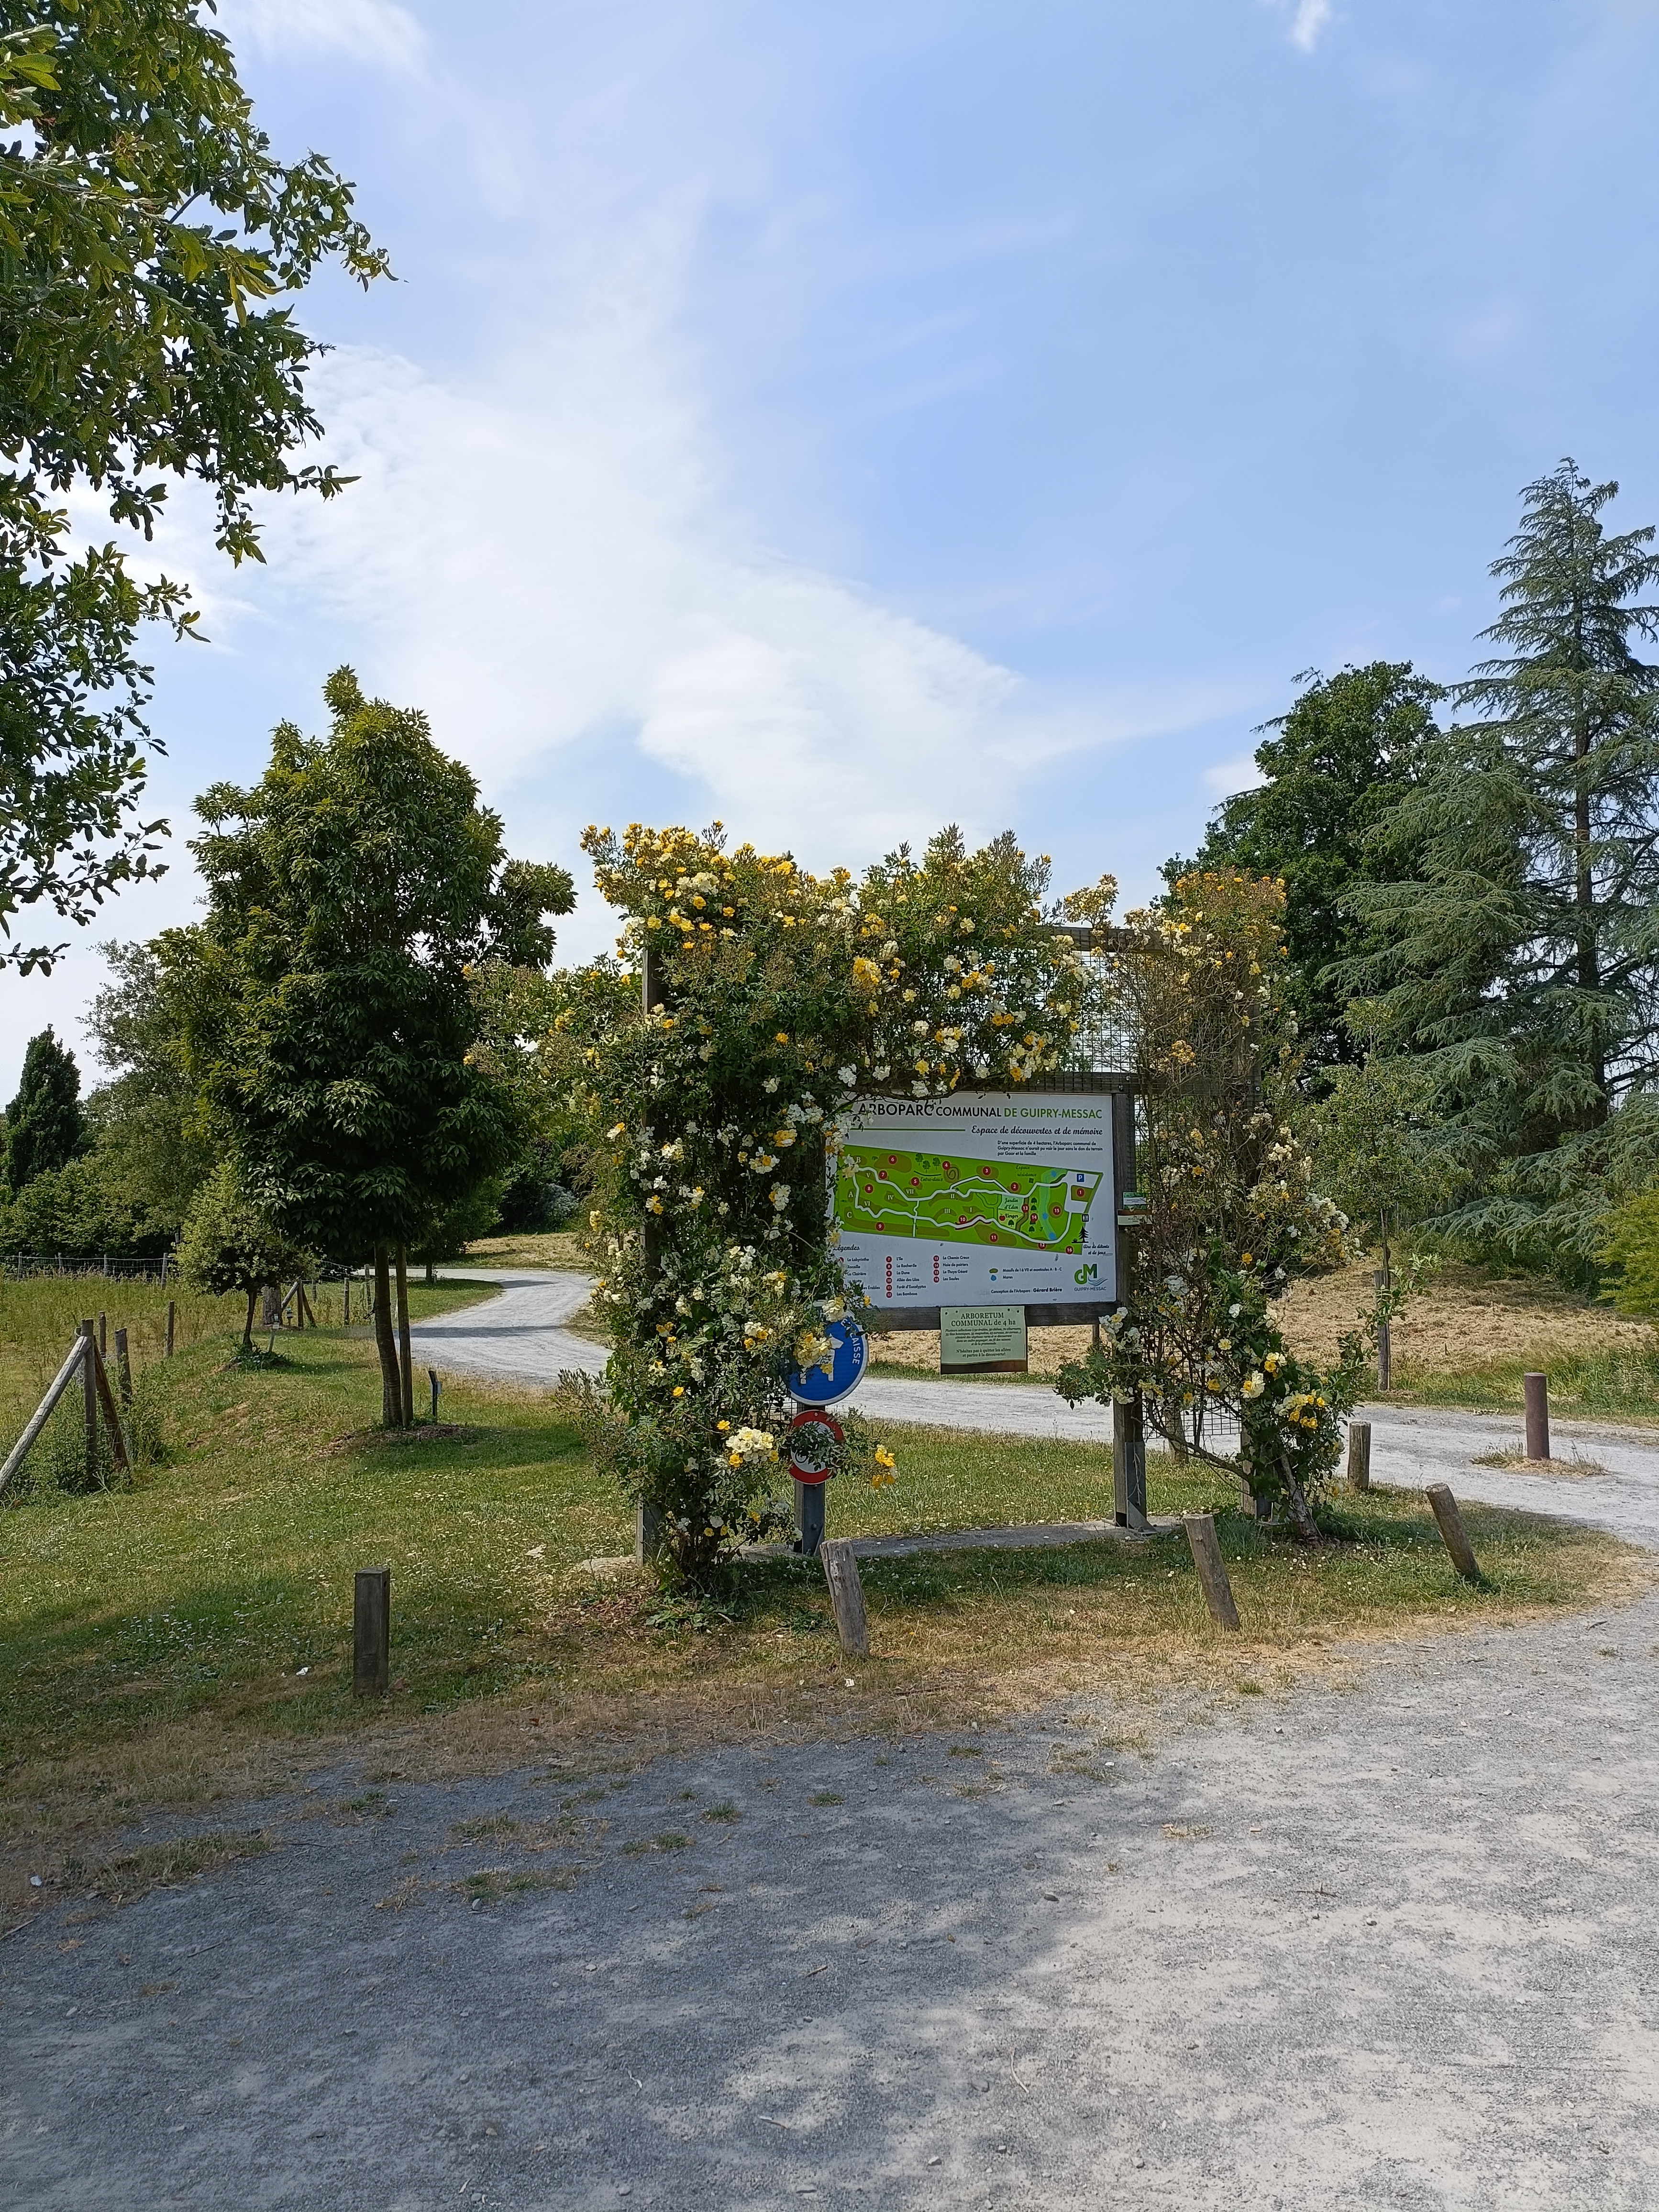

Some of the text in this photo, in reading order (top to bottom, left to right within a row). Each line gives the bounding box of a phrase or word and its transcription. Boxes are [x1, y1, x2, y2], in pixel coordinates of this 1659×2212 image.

[859, 1103, 1102, 1118] ARBOPARC COMMUNAL DE GUIPRY-MESSAC
[972, 1125, 998, 1136] Espace
[1000, 1126, 1008, 1134] de
[1010, 1126, 1052, 1134] découvertes
[1062, 1127, 1072, 1135] de
[1073, 1127, 1103, 1135] mémoire
